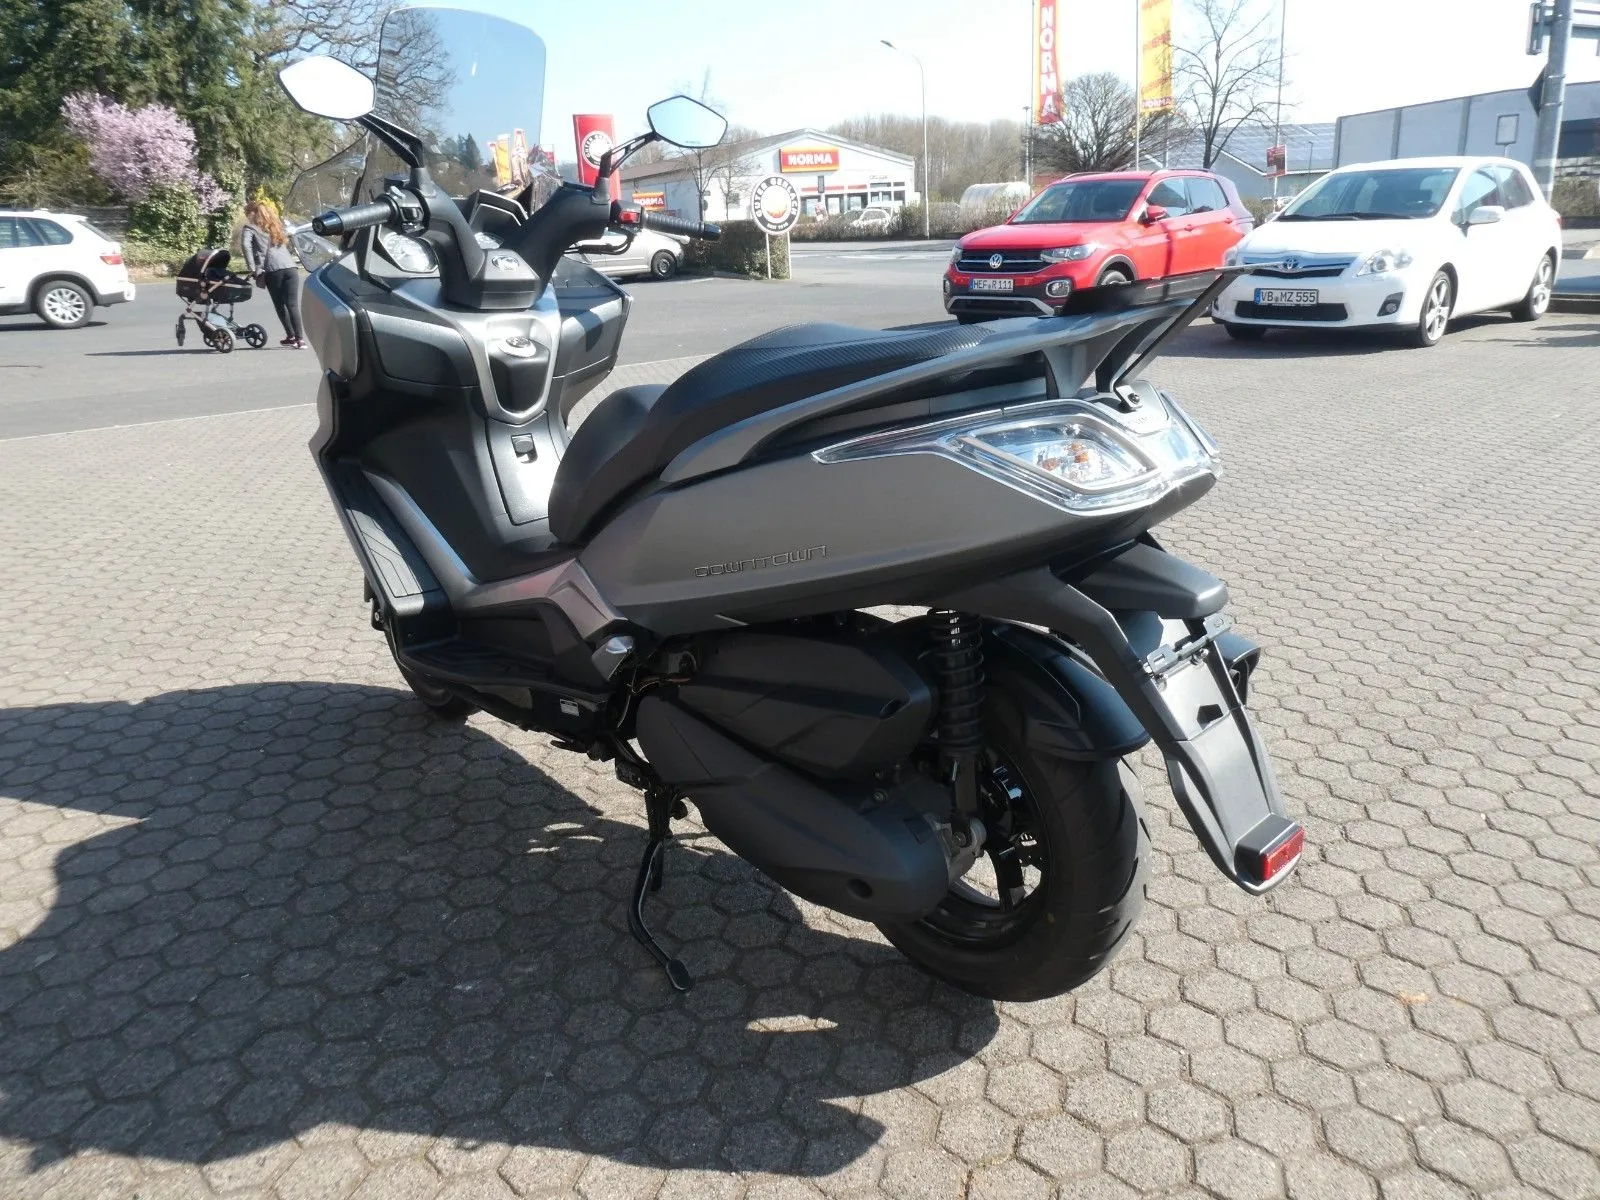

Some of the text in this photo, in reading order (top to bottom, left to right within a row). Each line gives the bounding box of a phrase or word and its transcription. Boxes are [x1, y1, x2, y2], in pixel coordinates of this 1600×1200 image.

[1040, 5, 1057, 116] NORMA
[788, 152, 833, 166] NORMA
[1261, 291, 1316, 303] VB MZ 555
